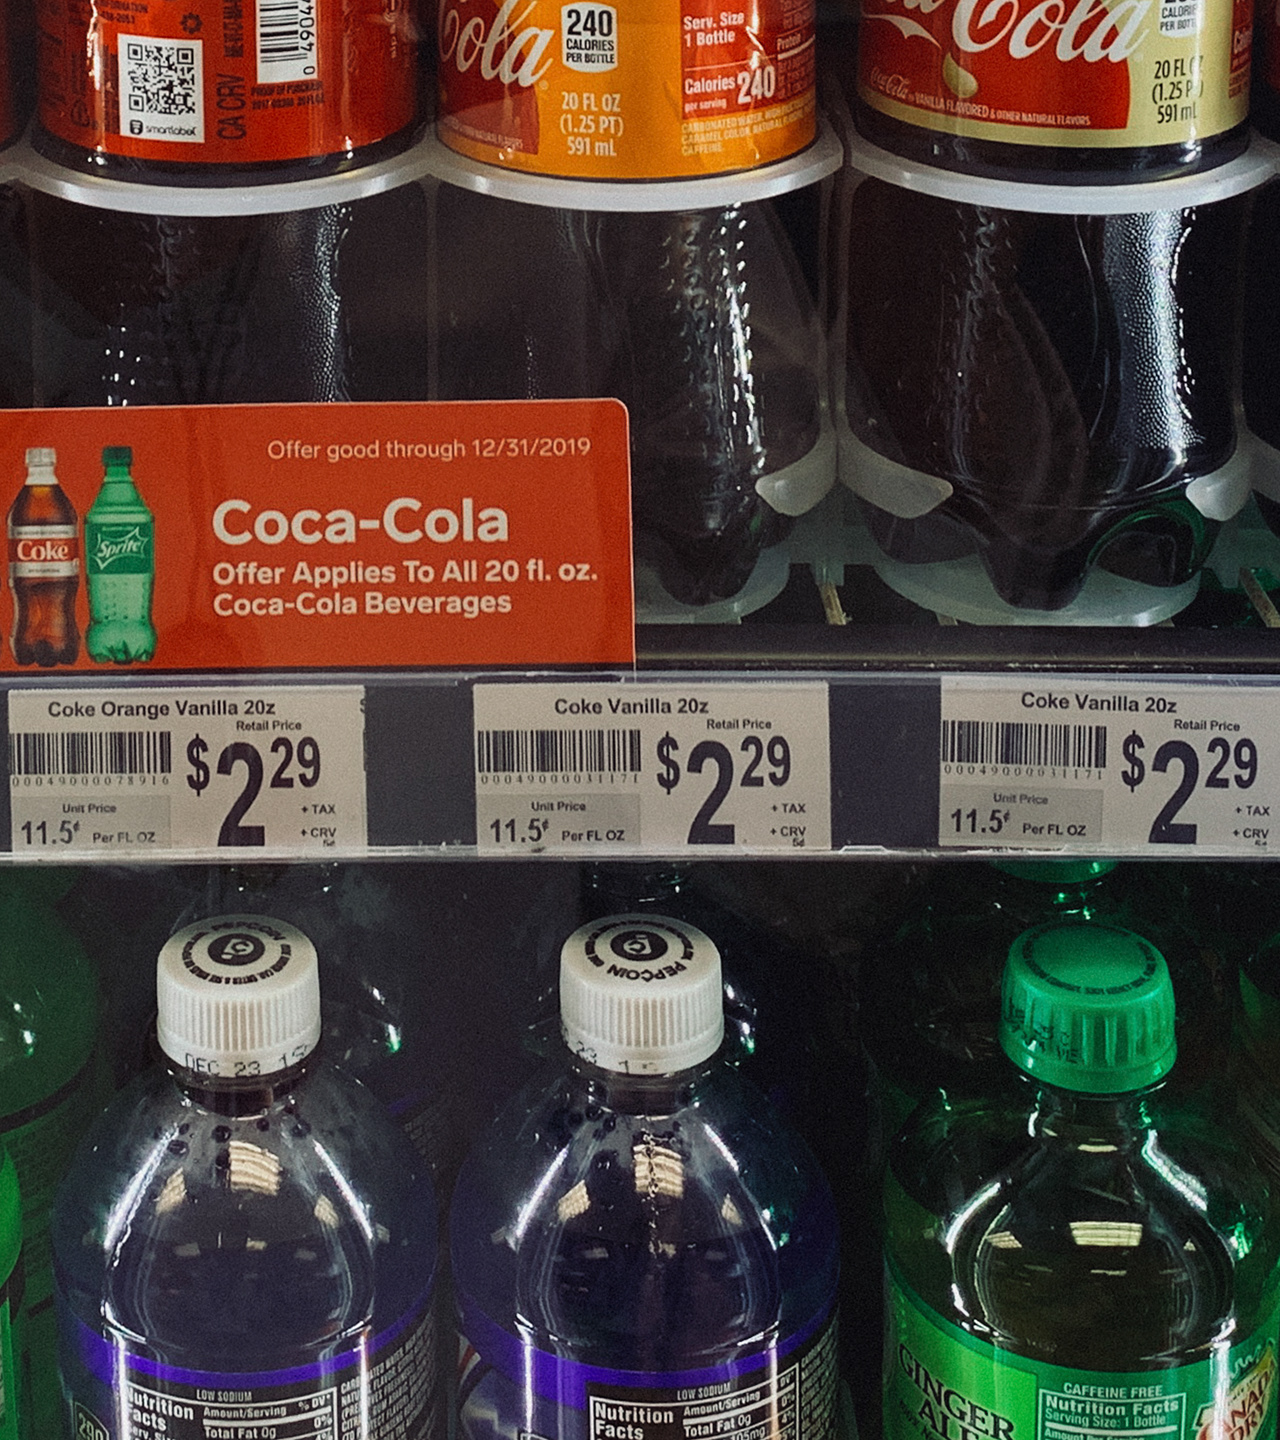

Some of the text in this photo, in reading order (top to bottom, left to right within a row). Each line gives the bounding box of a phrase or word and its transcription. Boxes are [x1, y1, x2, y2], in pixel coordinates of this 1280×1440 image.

[566, 9, 612, 38] 240
[566, 37, 615, 53] CALORIES
[566, 52, 615, 67] PER BOTTLE
[562, 92, 621, 111] 20 FL OZ
[560, 115, 624, 138] (1.25 PT)
[567, 138, 616, 156] 591 mL
[268, 436, 591, 463] Offer good through 12/31/2019
[213, 497, 508, 546] Coca-Cola
[213, 558, 597, 588] Offer Applies To All 20 fl. oz.
[213, 591, 511, 618] Coca-Cola Beverages
[48, 700, 96, 718] Coke
[102, 700, 168, 721] Orange
[174, 700, 238, 716] Vanilla
[196, 1390, 252, 1402] LOW SODIUM
[1063, 1383, 1162, 1398] CAFFEINE FREE
[595, 1402, 673, 1423] Nutrition
[596, 1422, 643, 1439] Facts
